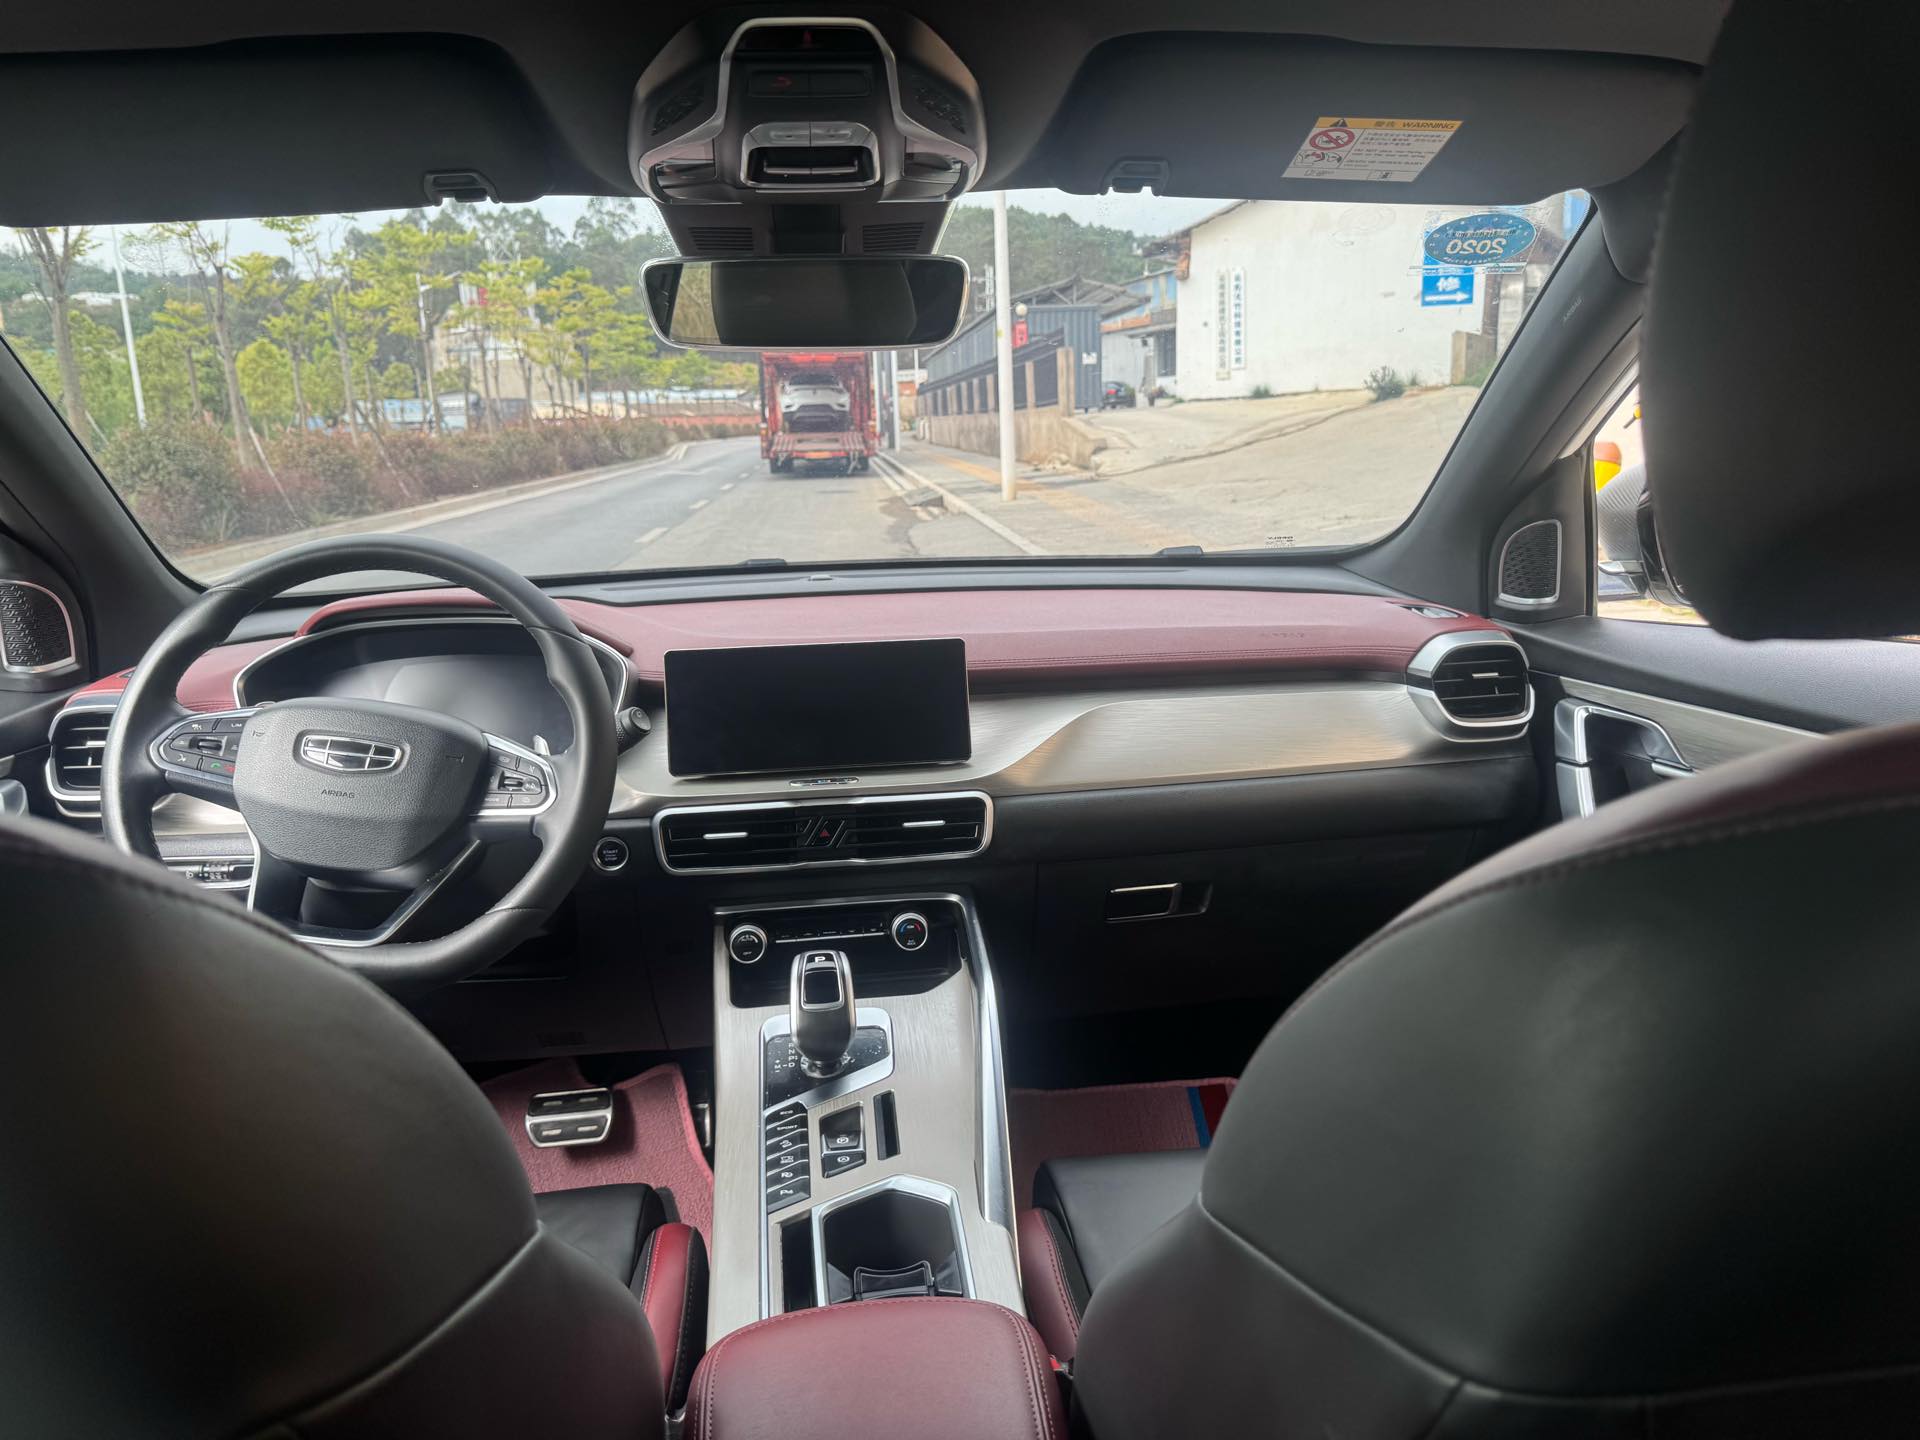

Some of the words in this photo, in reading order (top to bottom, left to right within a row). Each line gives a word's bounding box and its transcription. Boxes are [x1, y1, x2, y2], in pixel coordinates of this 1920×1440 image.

[1402, 121, 1456, 130] WARNING
[320, 788, 355, 799] AIRBAG
[814, 955, 826, 963] P
